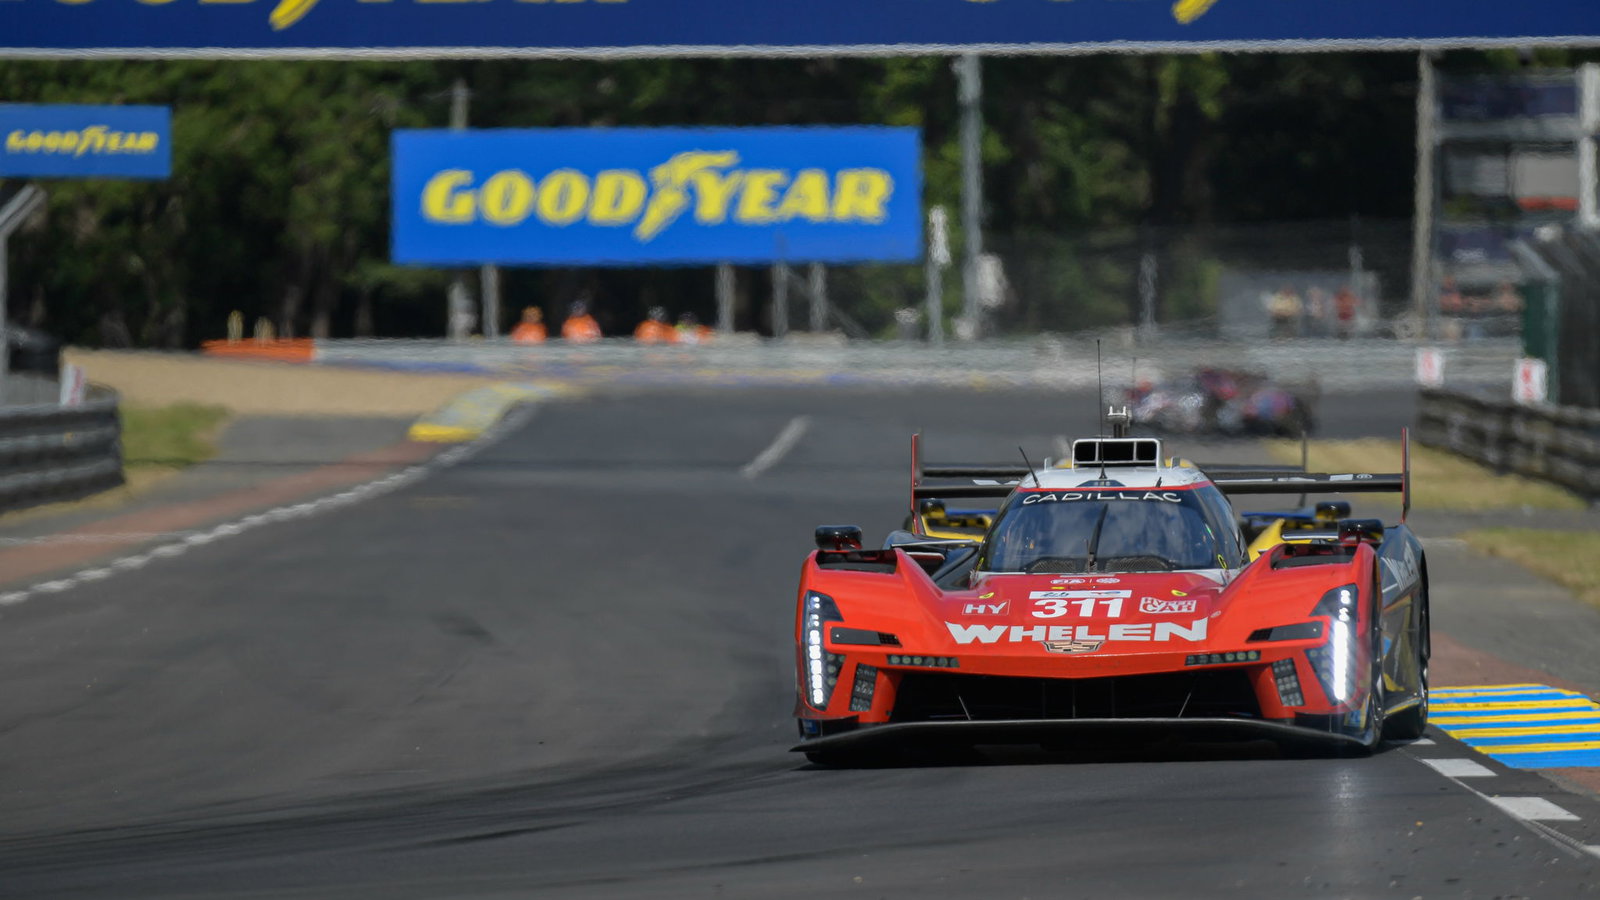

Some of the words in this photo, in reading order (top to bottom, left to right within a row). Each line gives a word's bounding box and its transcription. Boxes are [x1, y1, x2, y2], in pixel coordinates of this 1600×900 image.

[6, 128, 159, 155] GOODYEAR
[420, 166, 893, 228] GOODYEAR
[1022, 492, 1182, 505] CADILLAC
[964, 601, 1007, 615] HY
[1031, 598, 1123, 618] 311
[1142, 603, 1193, 612] CAR
[944, 616, 1208, 644] WHELEN
